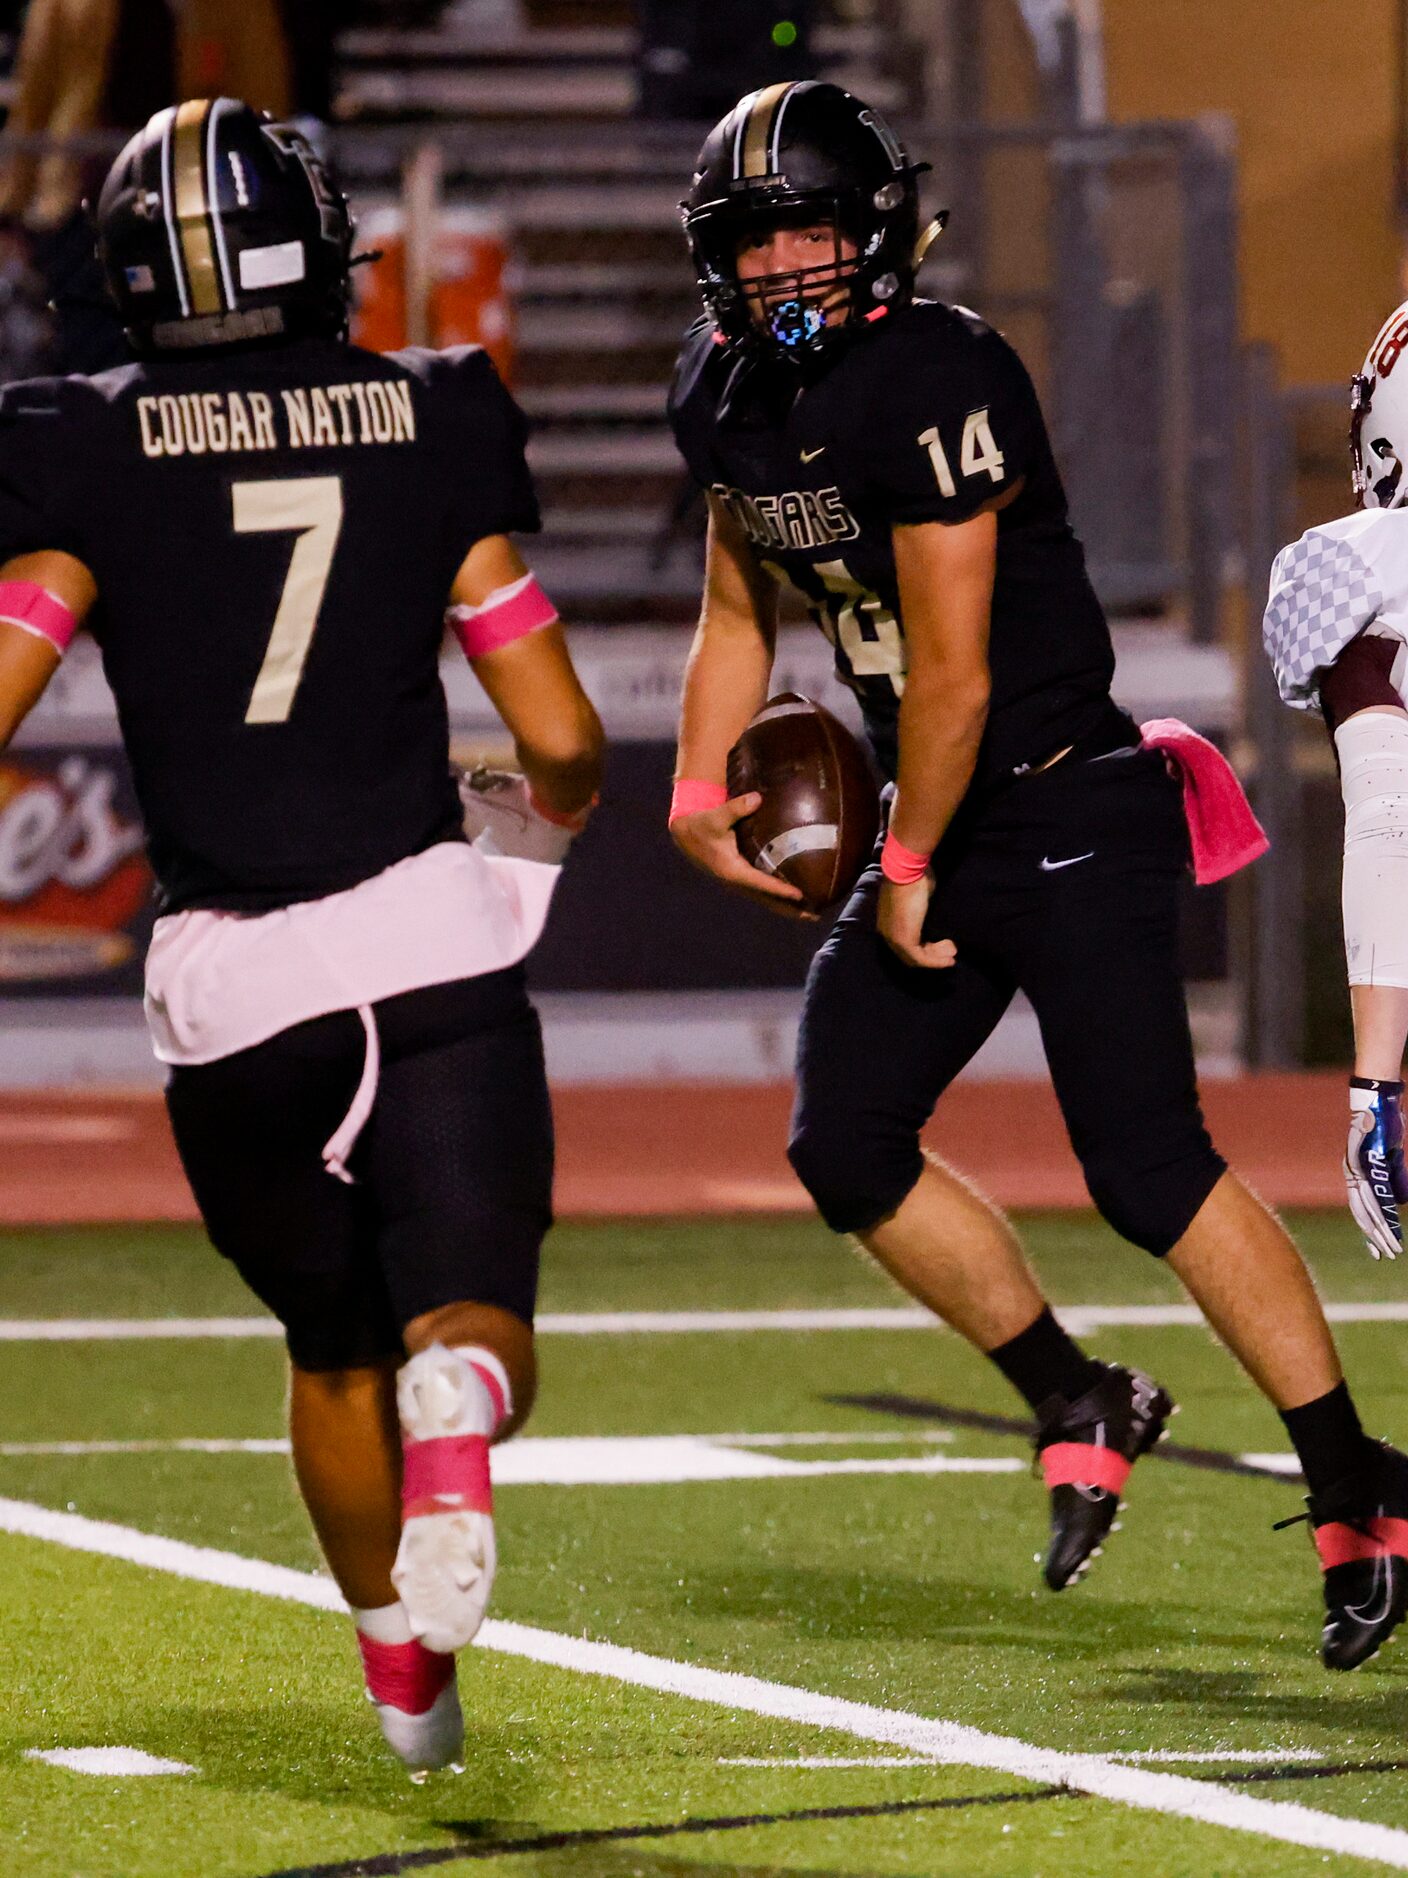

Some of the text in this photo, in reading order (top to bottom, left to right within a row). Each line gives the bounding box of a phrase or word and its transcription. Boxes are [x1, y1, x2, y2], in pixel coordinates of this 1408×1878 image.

[137, 380, 416, 457] COUGAR NATION
[917, 405, 1005, 498] 14
[232, 476, 344, 723] 7
[1367, 1149, 1401, 1231] VAPOR
